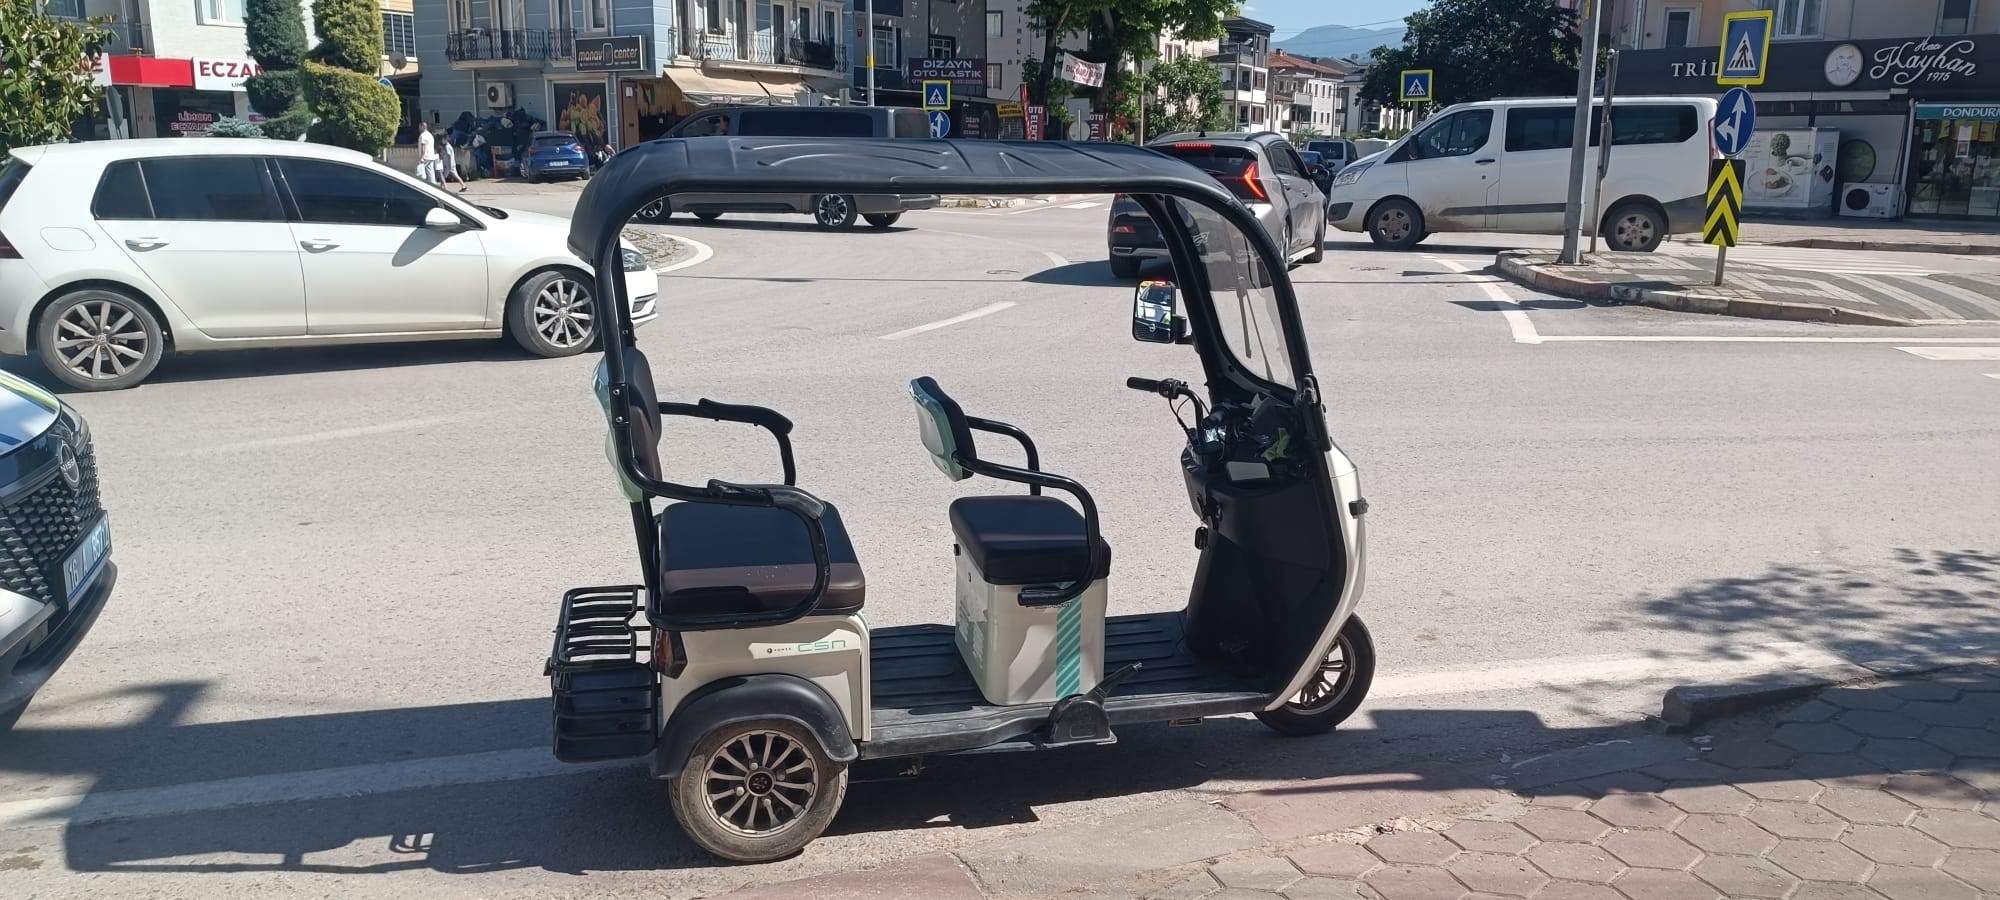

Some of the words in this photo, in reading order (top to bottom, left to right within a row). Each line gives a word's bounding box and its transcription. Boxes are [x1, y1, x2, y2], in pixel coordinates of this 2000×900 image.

[578, 50, 603, 61] manav
[614, 48, 638, 58] center
[1869, 40, 1976, 84] Kayhan
[1028, 106, 1043, 114] OTO
